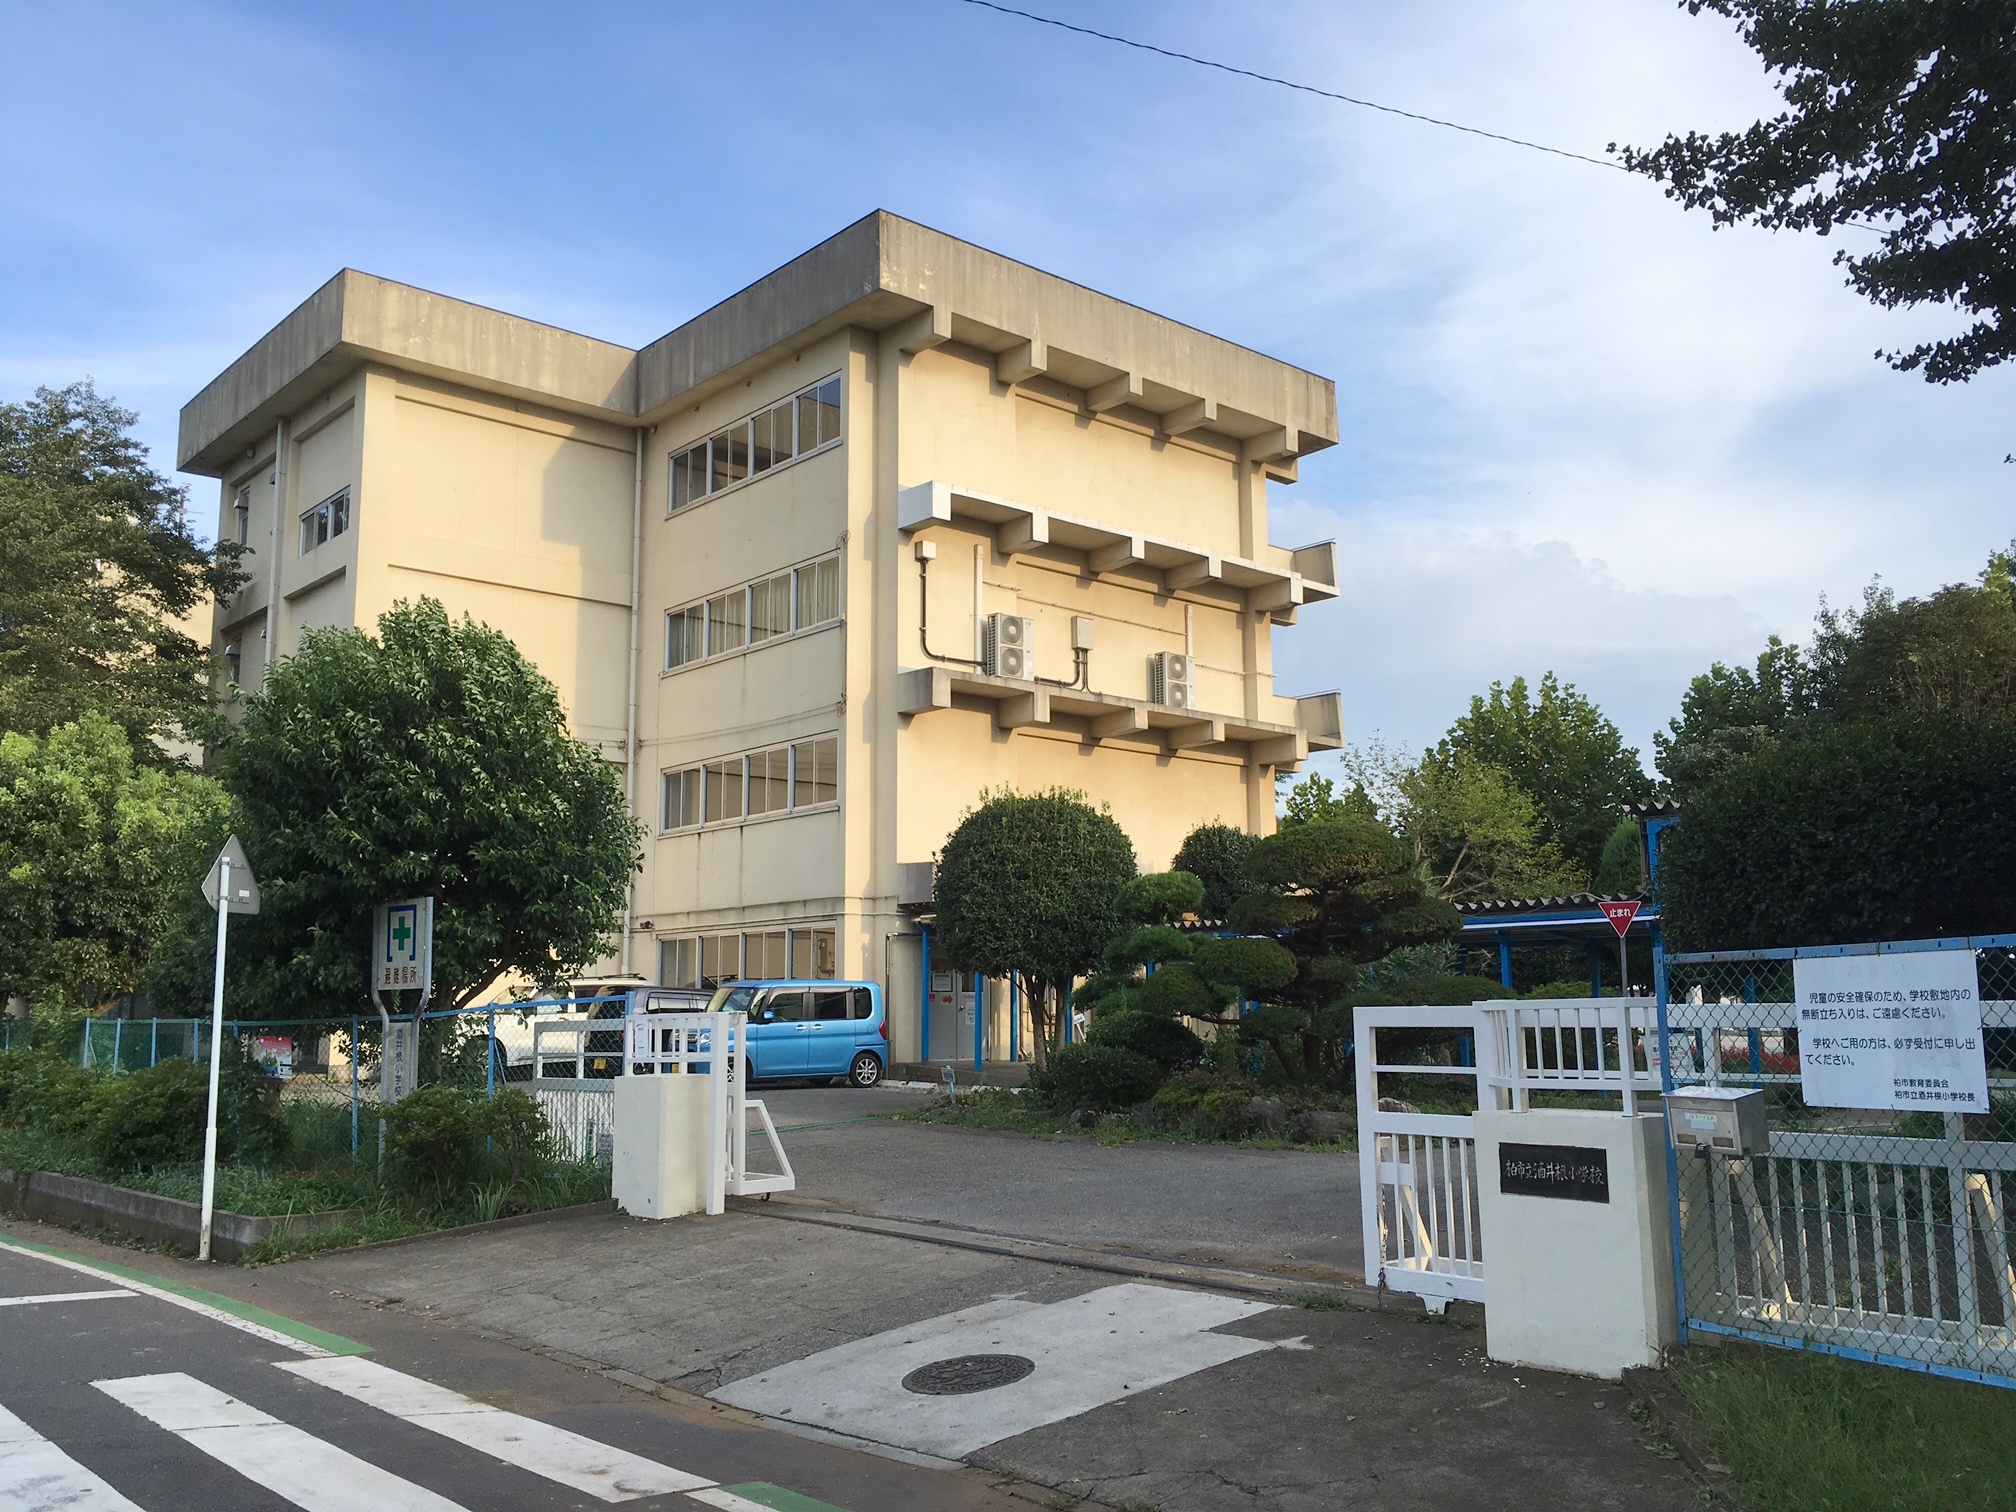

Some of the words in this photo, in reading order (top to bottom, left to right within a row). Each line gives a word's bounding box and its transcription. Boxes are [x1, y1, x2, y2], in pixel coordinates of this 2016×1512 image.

[1610, 908, 1631, 918] 止まれ
[1809, 989, 1971, 1004] 児童の安全確保のため、学校敷地内の
[1801, 1007, 1946, 1020] 無断立ち入りは、ご遠慮ください。
[1812, 1037, 1976, 1050] 学校へご用の方は、必ず受付に申し出
[1805, 1053, 1855, 1066] てください。
[1893, 1078, 1949, 1088] 柏市教育委員会
[1894, 1090, 1976, 1102] 柏市立酒井根小学校長
[1505, 1160, 1605, 1184] 柏市立酒井根小学校
